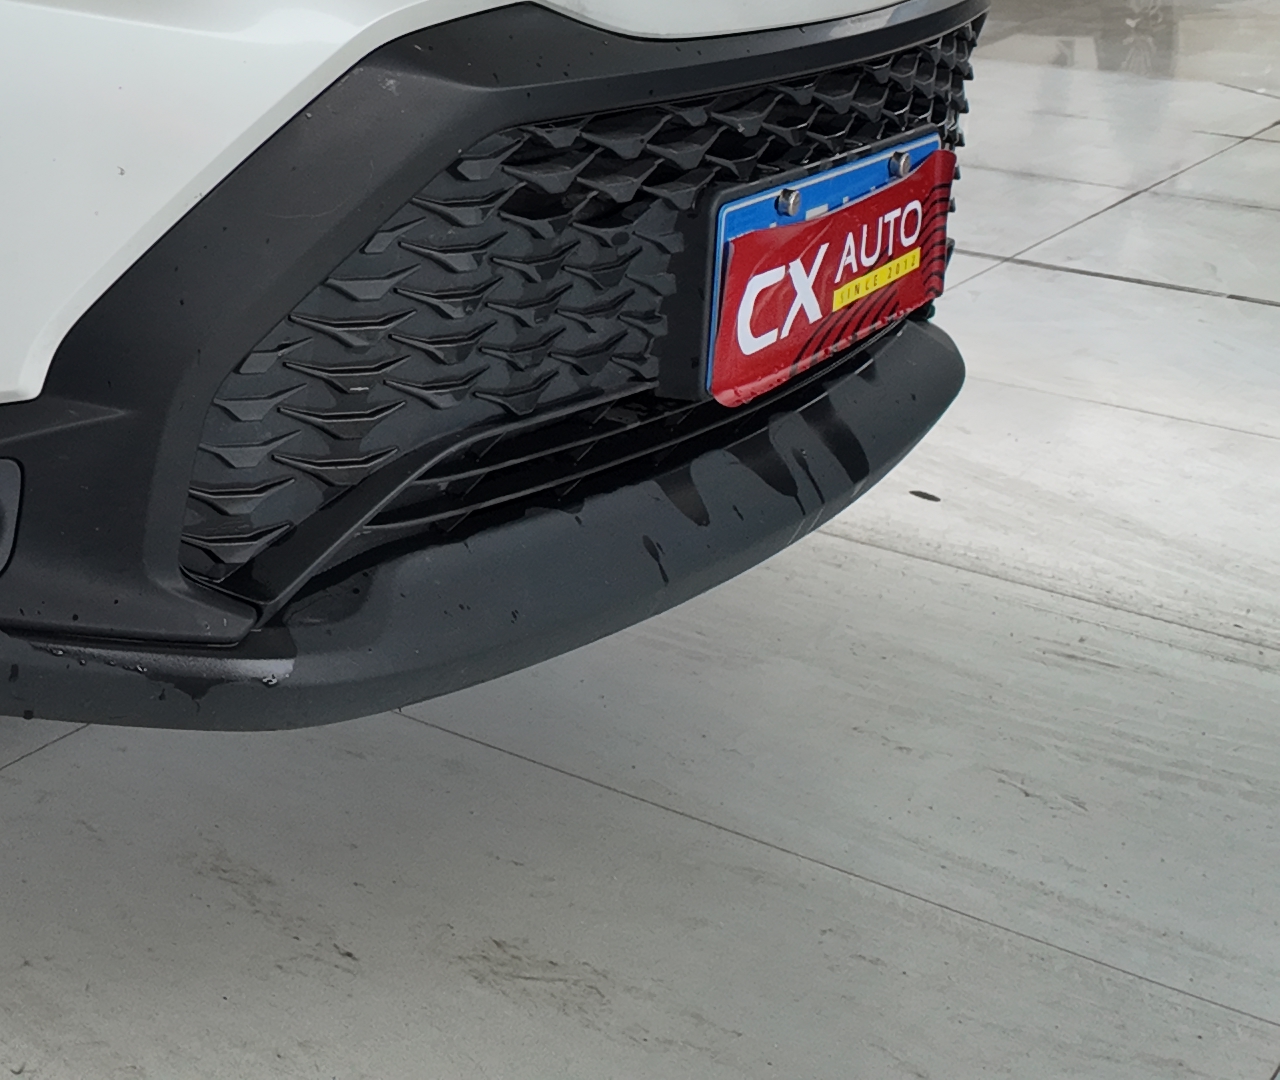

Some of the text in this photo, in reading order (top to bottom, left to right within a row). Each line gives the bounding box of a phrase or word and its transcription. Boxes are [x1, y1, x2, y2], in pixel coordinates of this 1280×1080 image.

[736, 199, 923, 356] CX AUTO
[840, 253, 917, 304] SINCE 2012
